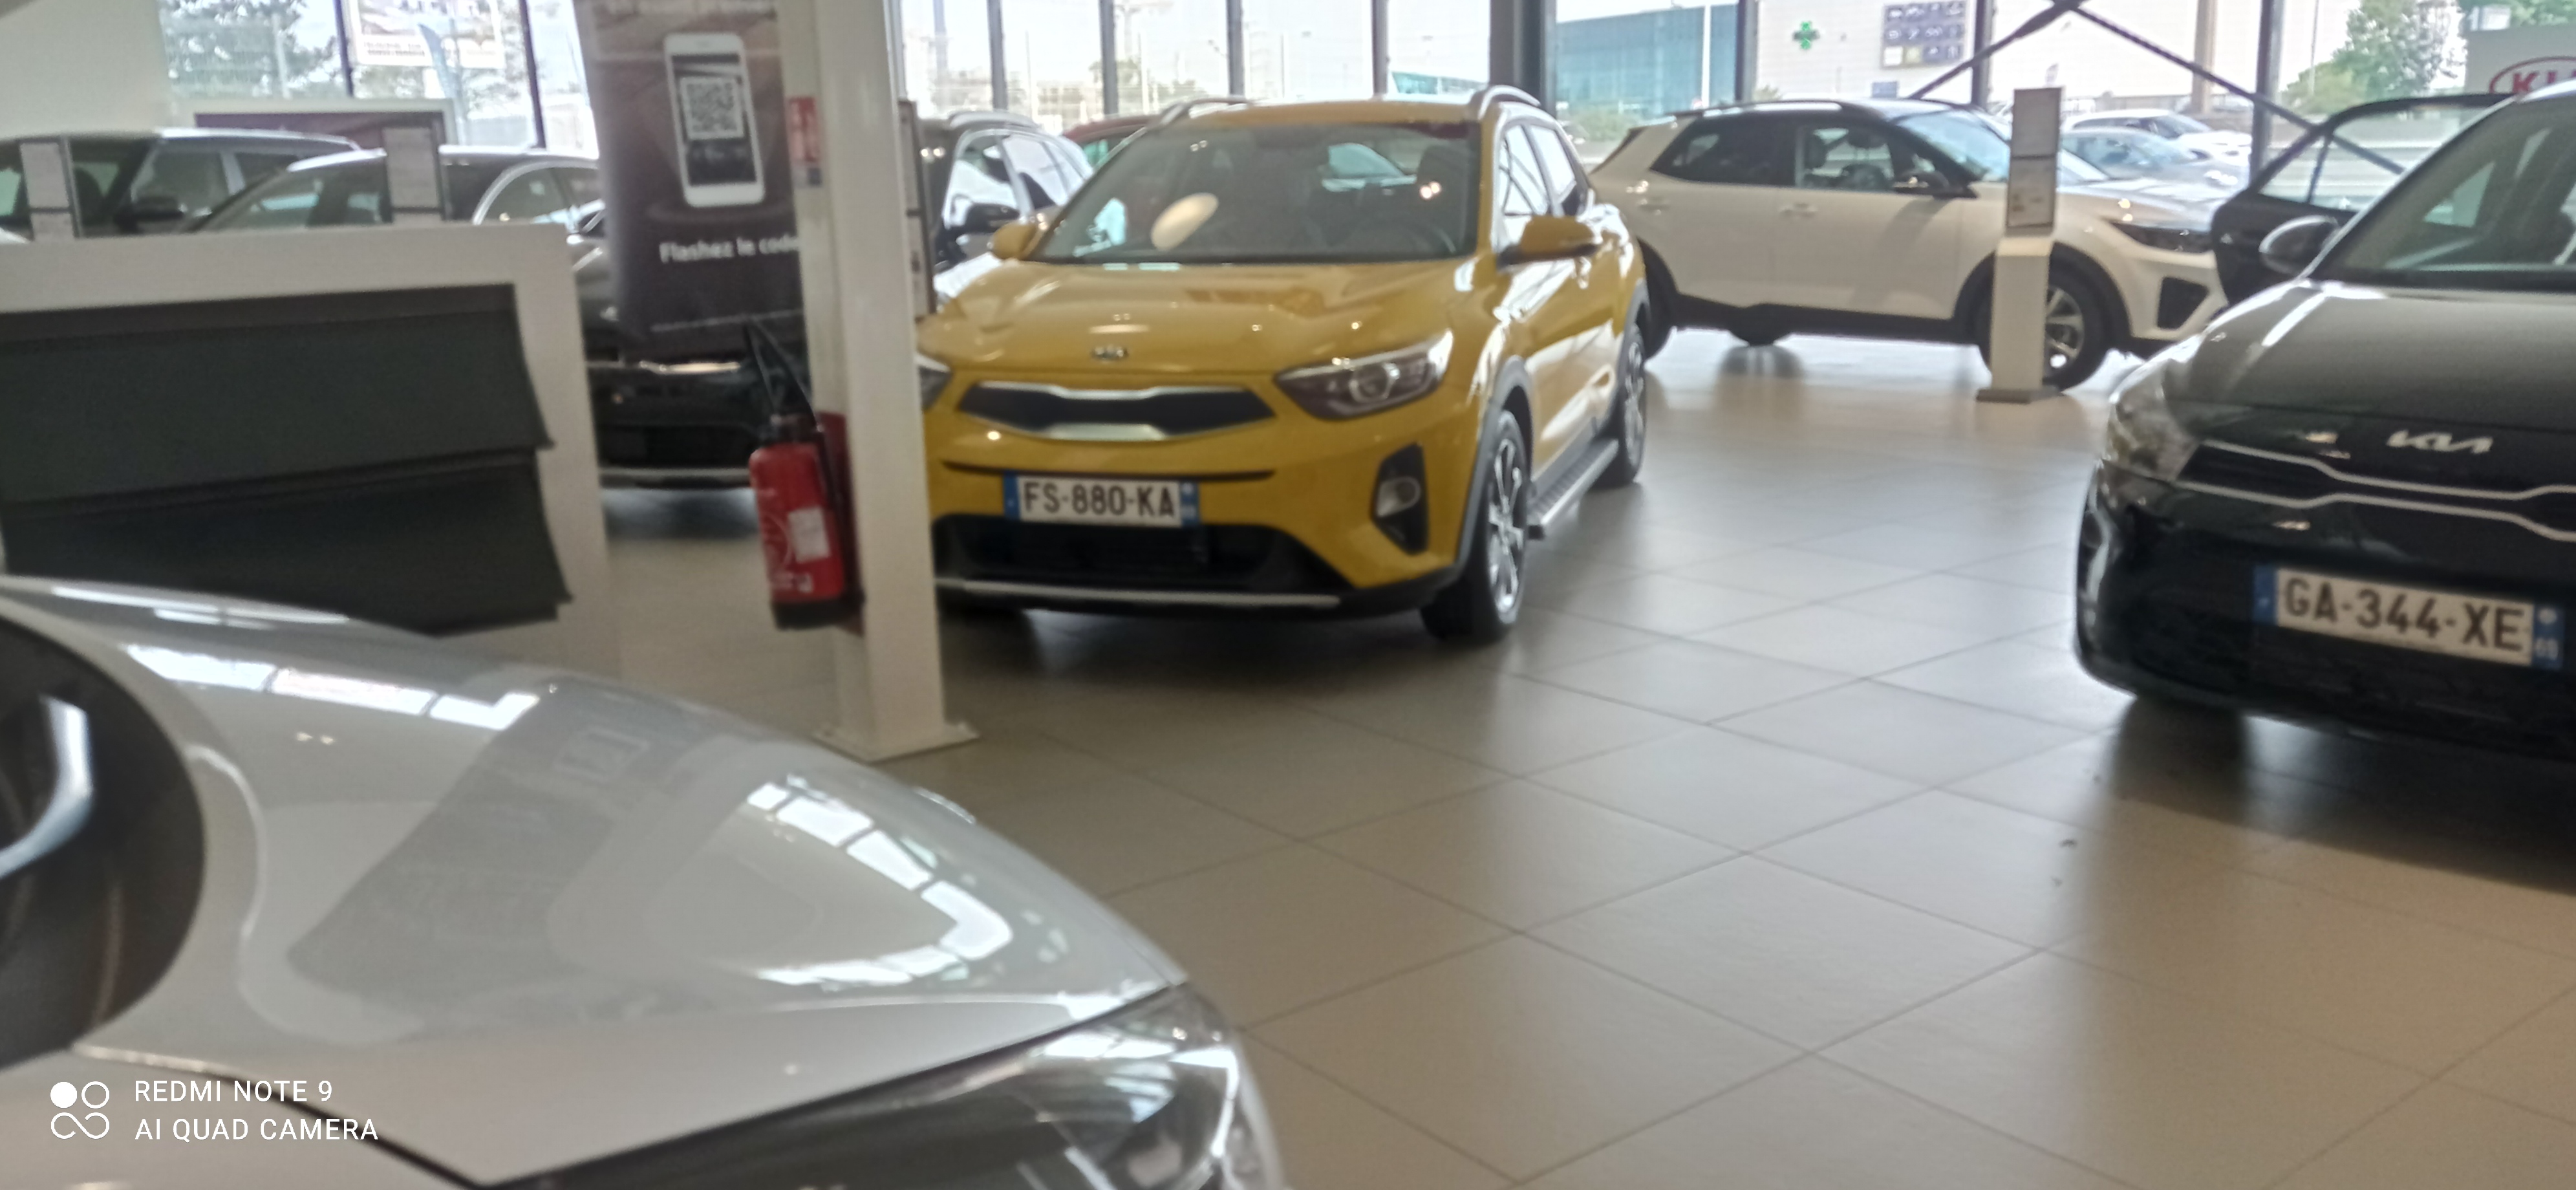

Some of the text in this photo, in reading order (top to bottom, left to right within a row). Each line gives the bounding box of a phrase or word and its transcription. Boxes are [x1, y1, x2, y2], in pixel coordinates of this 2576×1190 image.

[2512, 69, 2576, 95] KI
[659, 240, 735, 263] Flashez
[736, 237, 756, 256] le
[1024, 482, 1174, 517] FS-880-KA
[2283, 577, 2526, 651] GA-344-XE
